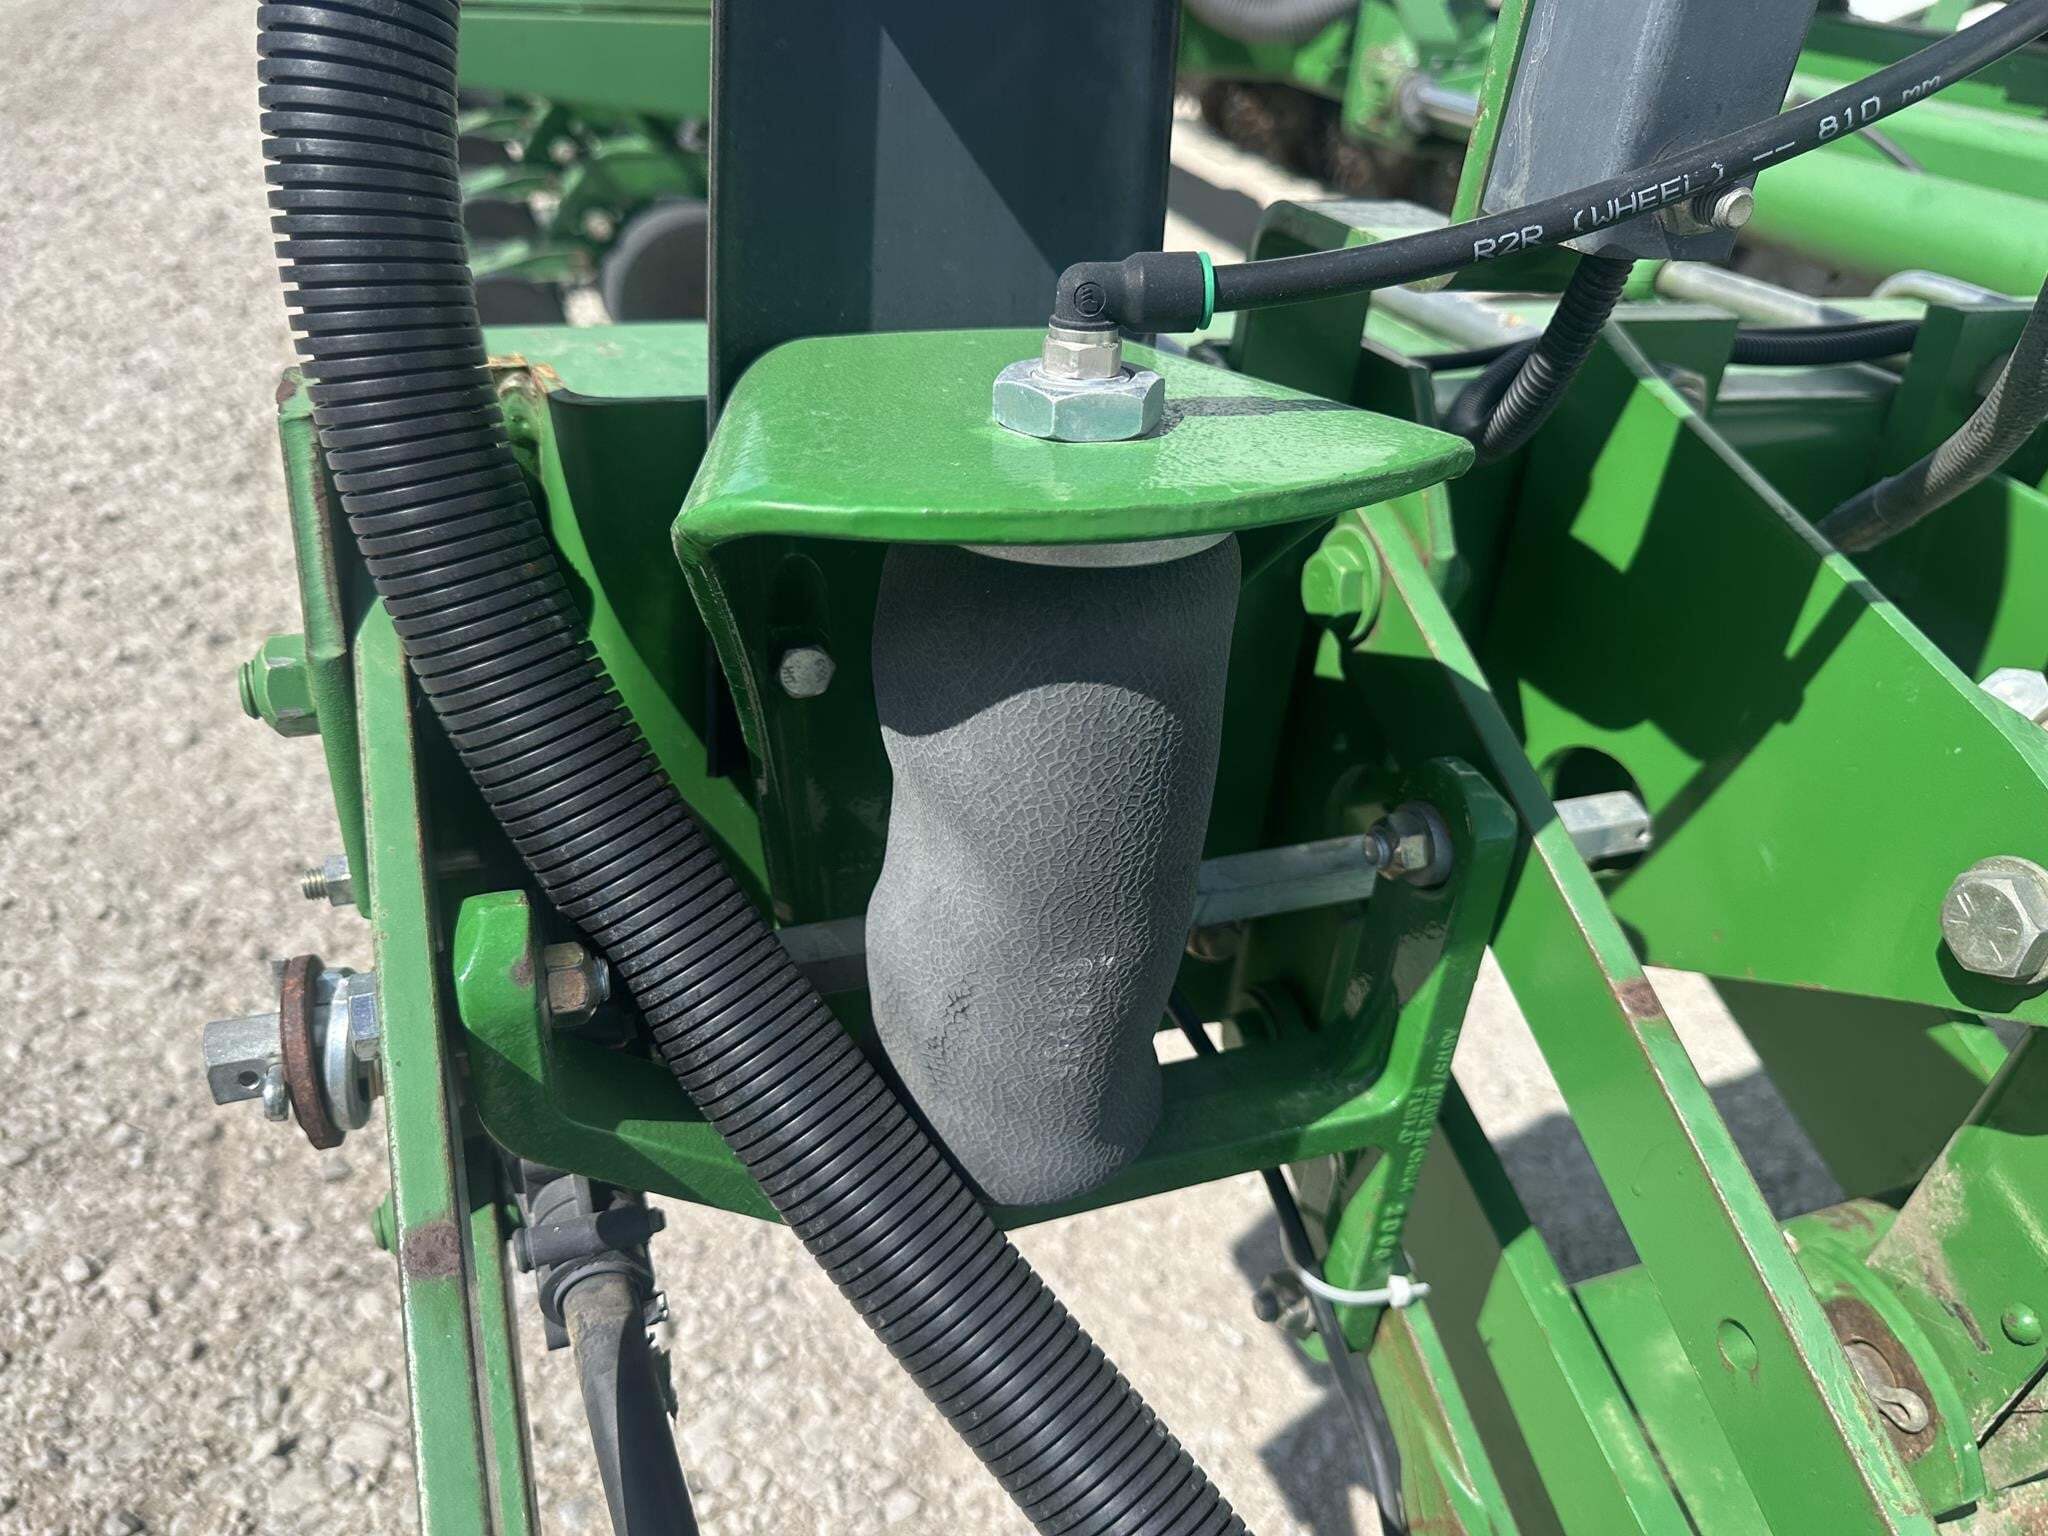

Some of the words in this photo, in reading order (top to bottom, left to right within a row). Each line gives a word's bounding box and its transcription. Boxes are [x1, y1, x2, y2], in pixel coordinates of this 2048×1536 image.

[1473, 224, 1544, 263] R2R
[1573, 161, 1725, 233] (WHEEL)
[1902, 74, 1943, 104] mm
